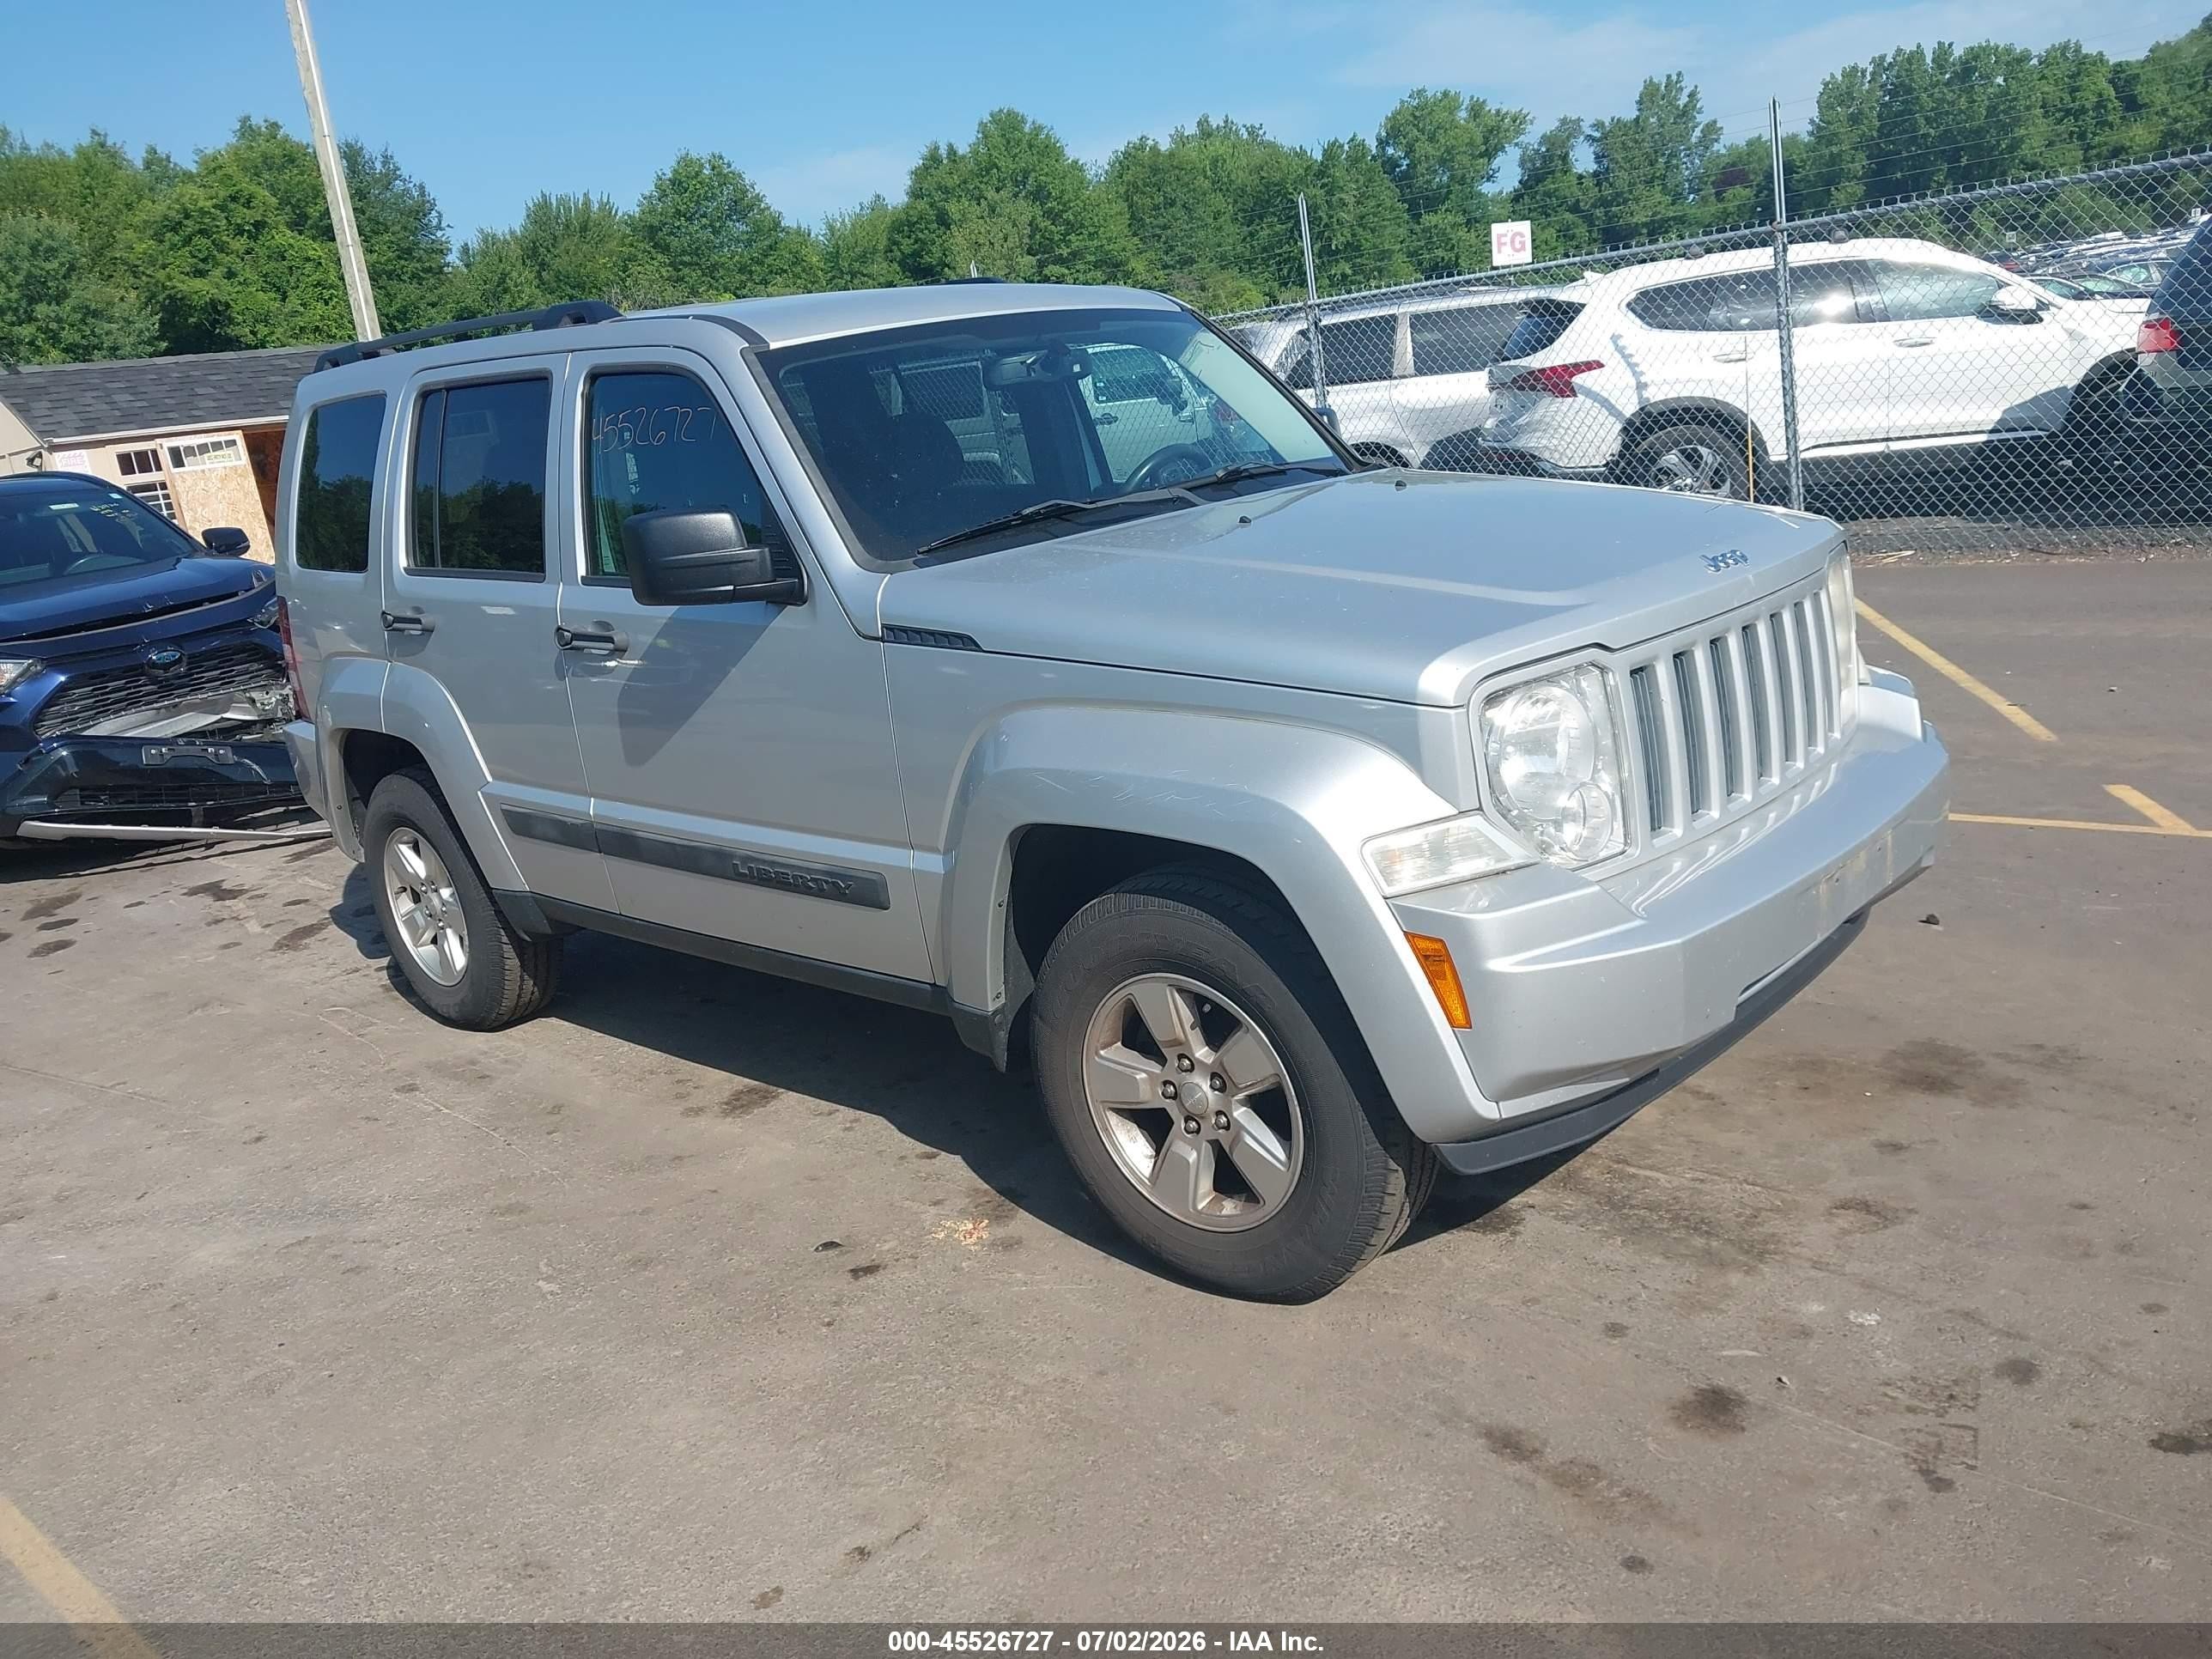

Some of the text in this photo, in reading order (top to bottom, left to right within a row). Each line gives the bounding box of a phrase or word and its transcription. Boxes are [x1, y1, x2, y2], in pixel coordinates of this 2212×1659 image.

[1497, 231, 1526, 254] FG
[592, 405, 718, 453] 45526727
[1698, 549, 1750, 573] Jeep
[732, 860, 854, 895] LIBERTY
